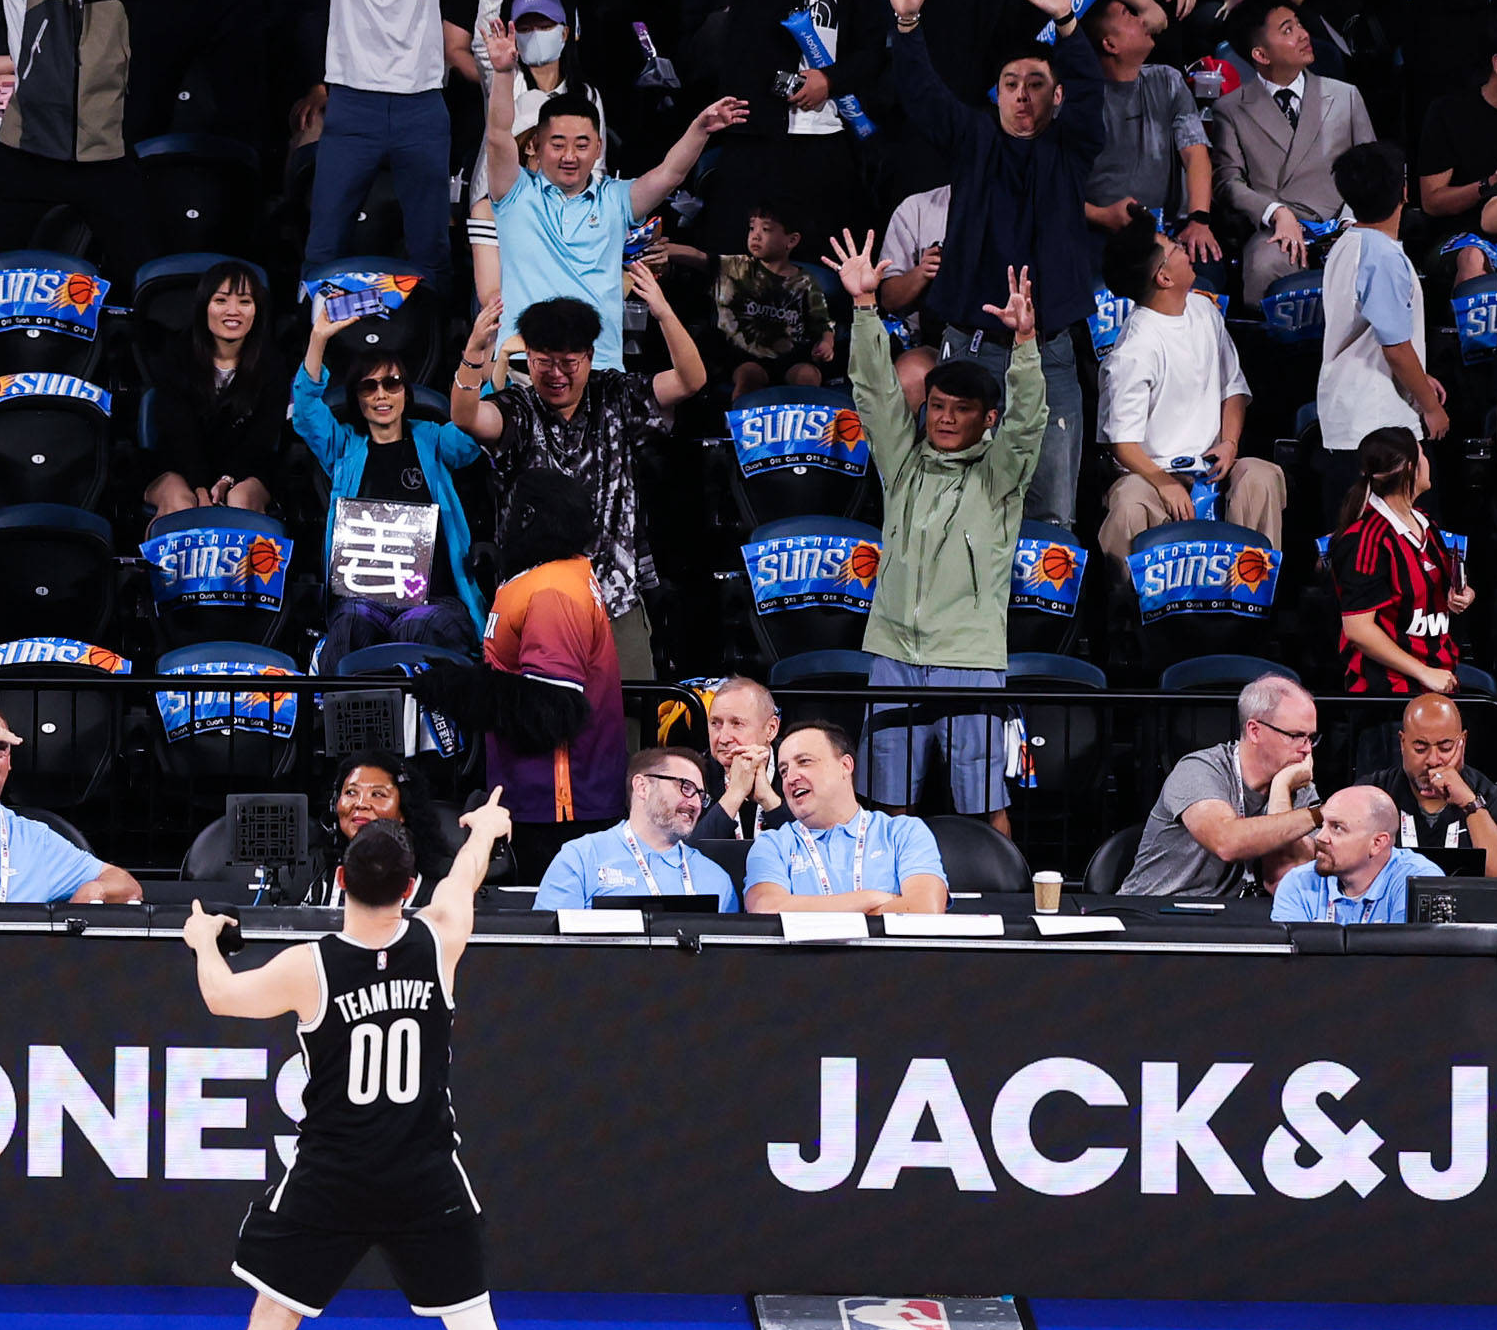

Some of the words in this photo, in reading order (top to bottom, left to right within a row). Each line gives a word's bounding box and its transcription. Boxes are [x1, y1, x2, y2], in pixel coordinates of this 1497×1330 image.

[741, 410, 829, 449] SUNS
[158, 534, 247, 554] PHOENIX
[1144, 543, 1234, 565] PHOENIX
[159, 548, 244, 585] SUNS
[757, 549, 846, 587] SUNS
[1143, 554, 1231, 598] SUNS
[1406, 607, 1450, 638] bw
[333, 981, 389, 1024] TEAM
[389, 979, 435, 1012] HYPE
[347, 1017, 421, 1106] 00
